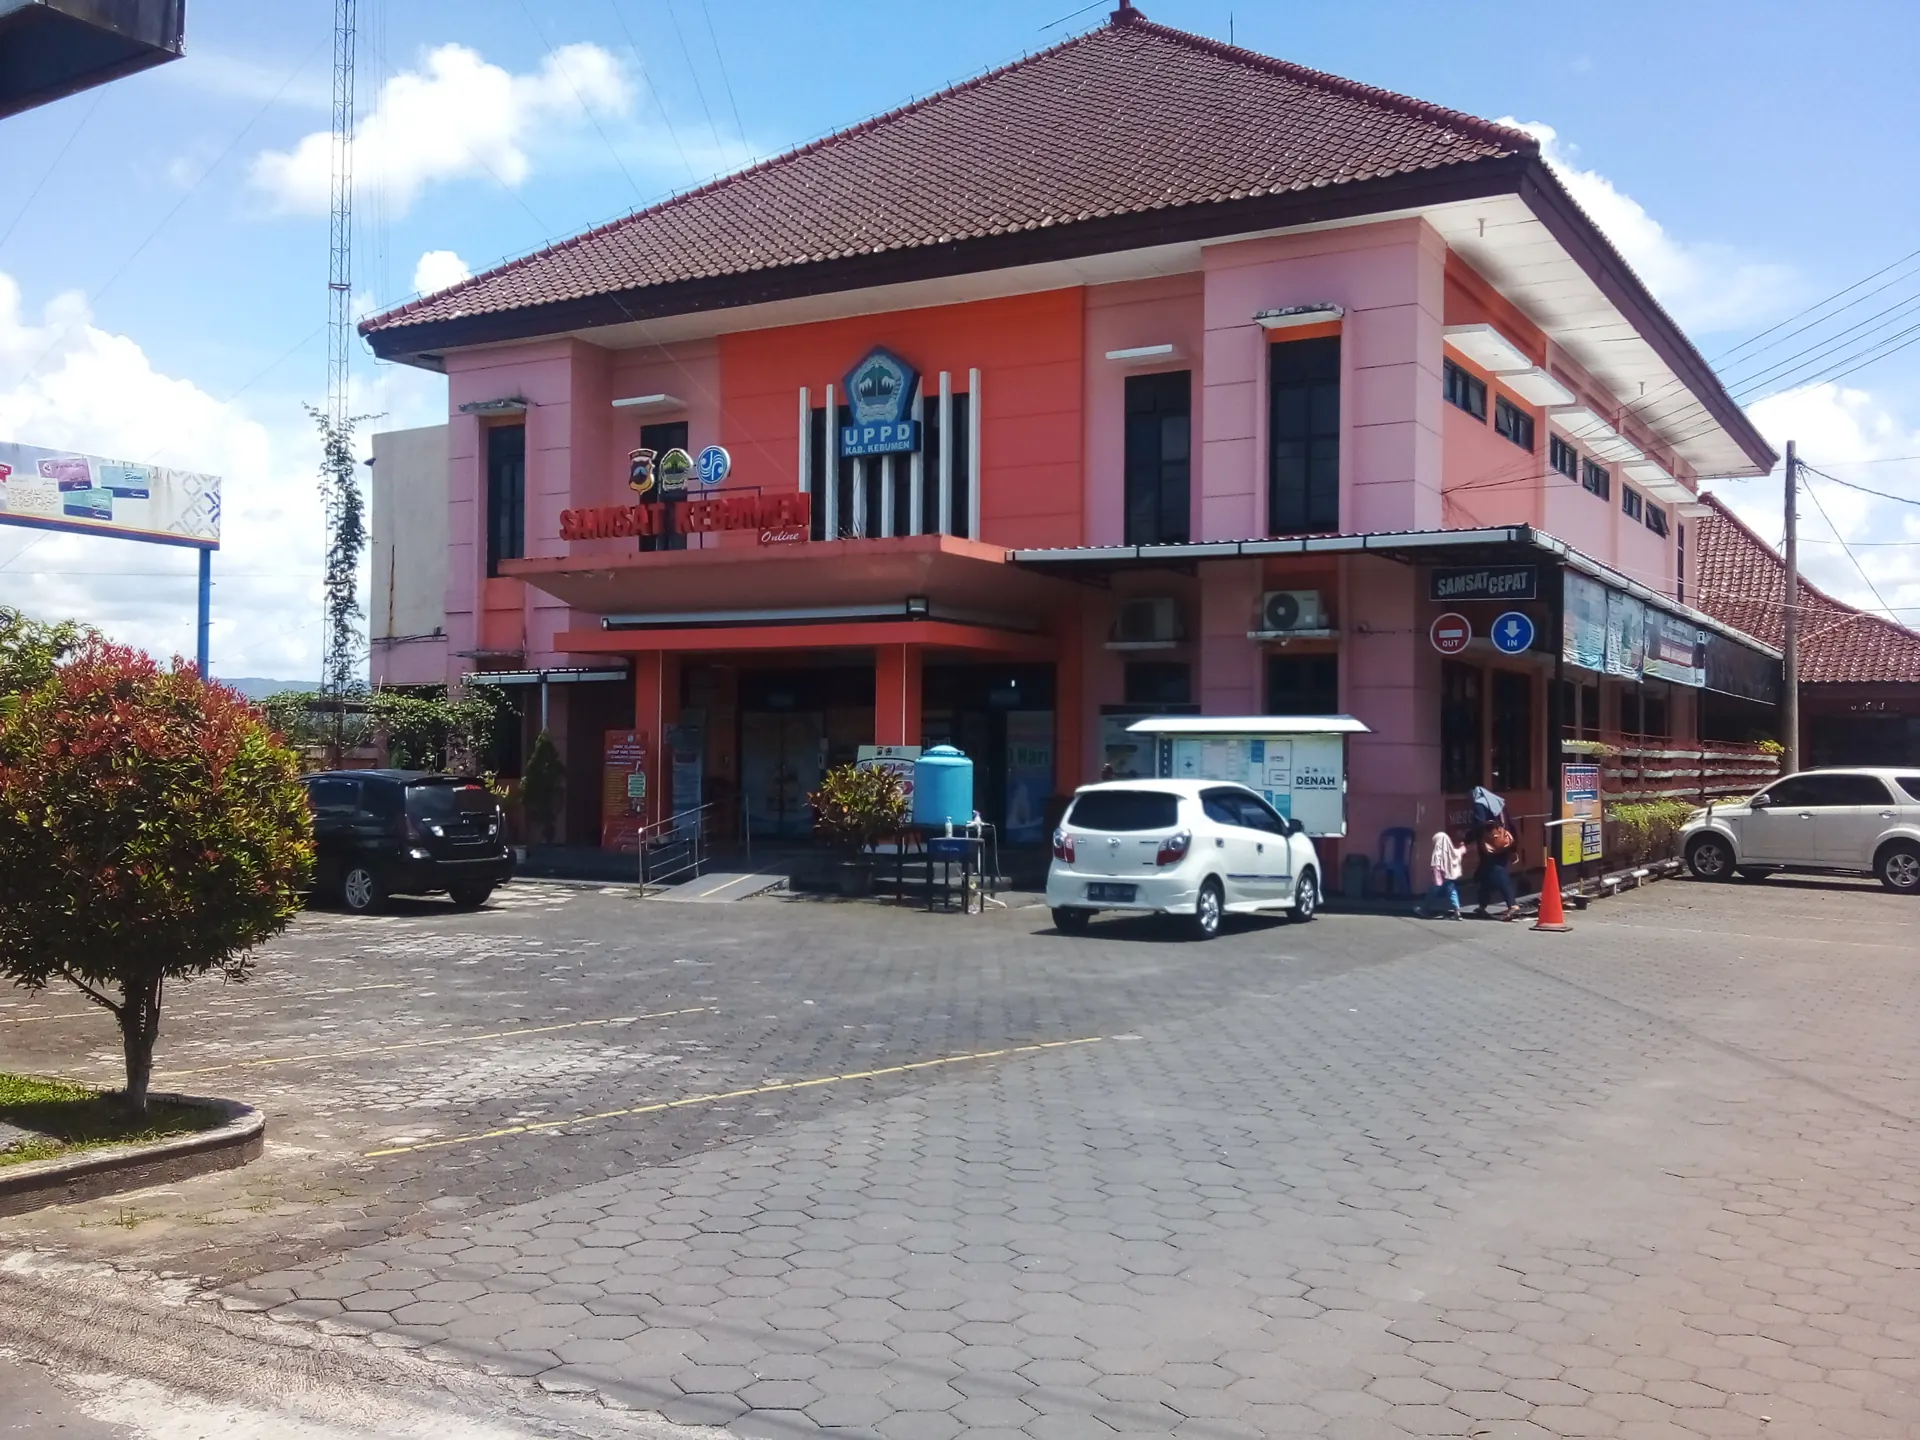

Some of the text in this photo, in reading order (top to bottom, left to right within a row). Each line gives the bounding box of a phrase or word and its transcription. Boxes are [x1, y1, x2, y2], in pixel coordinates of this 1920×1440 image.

[845, 424, 910, 445] UPPD
[845, 440, 910, 455] KAB. KEBUMEN
[559, 492, 810, 541] SAMSAT KEBUMEN
[761, 530, 801, 543] Online
[1437, 571, 1529, 596] SAMSAT CEPAT
[1442, 639, 1459, 648] OUT
[1507, 639, 1518, 648] IN
[1295, 775, 1336, 786] DENAH
